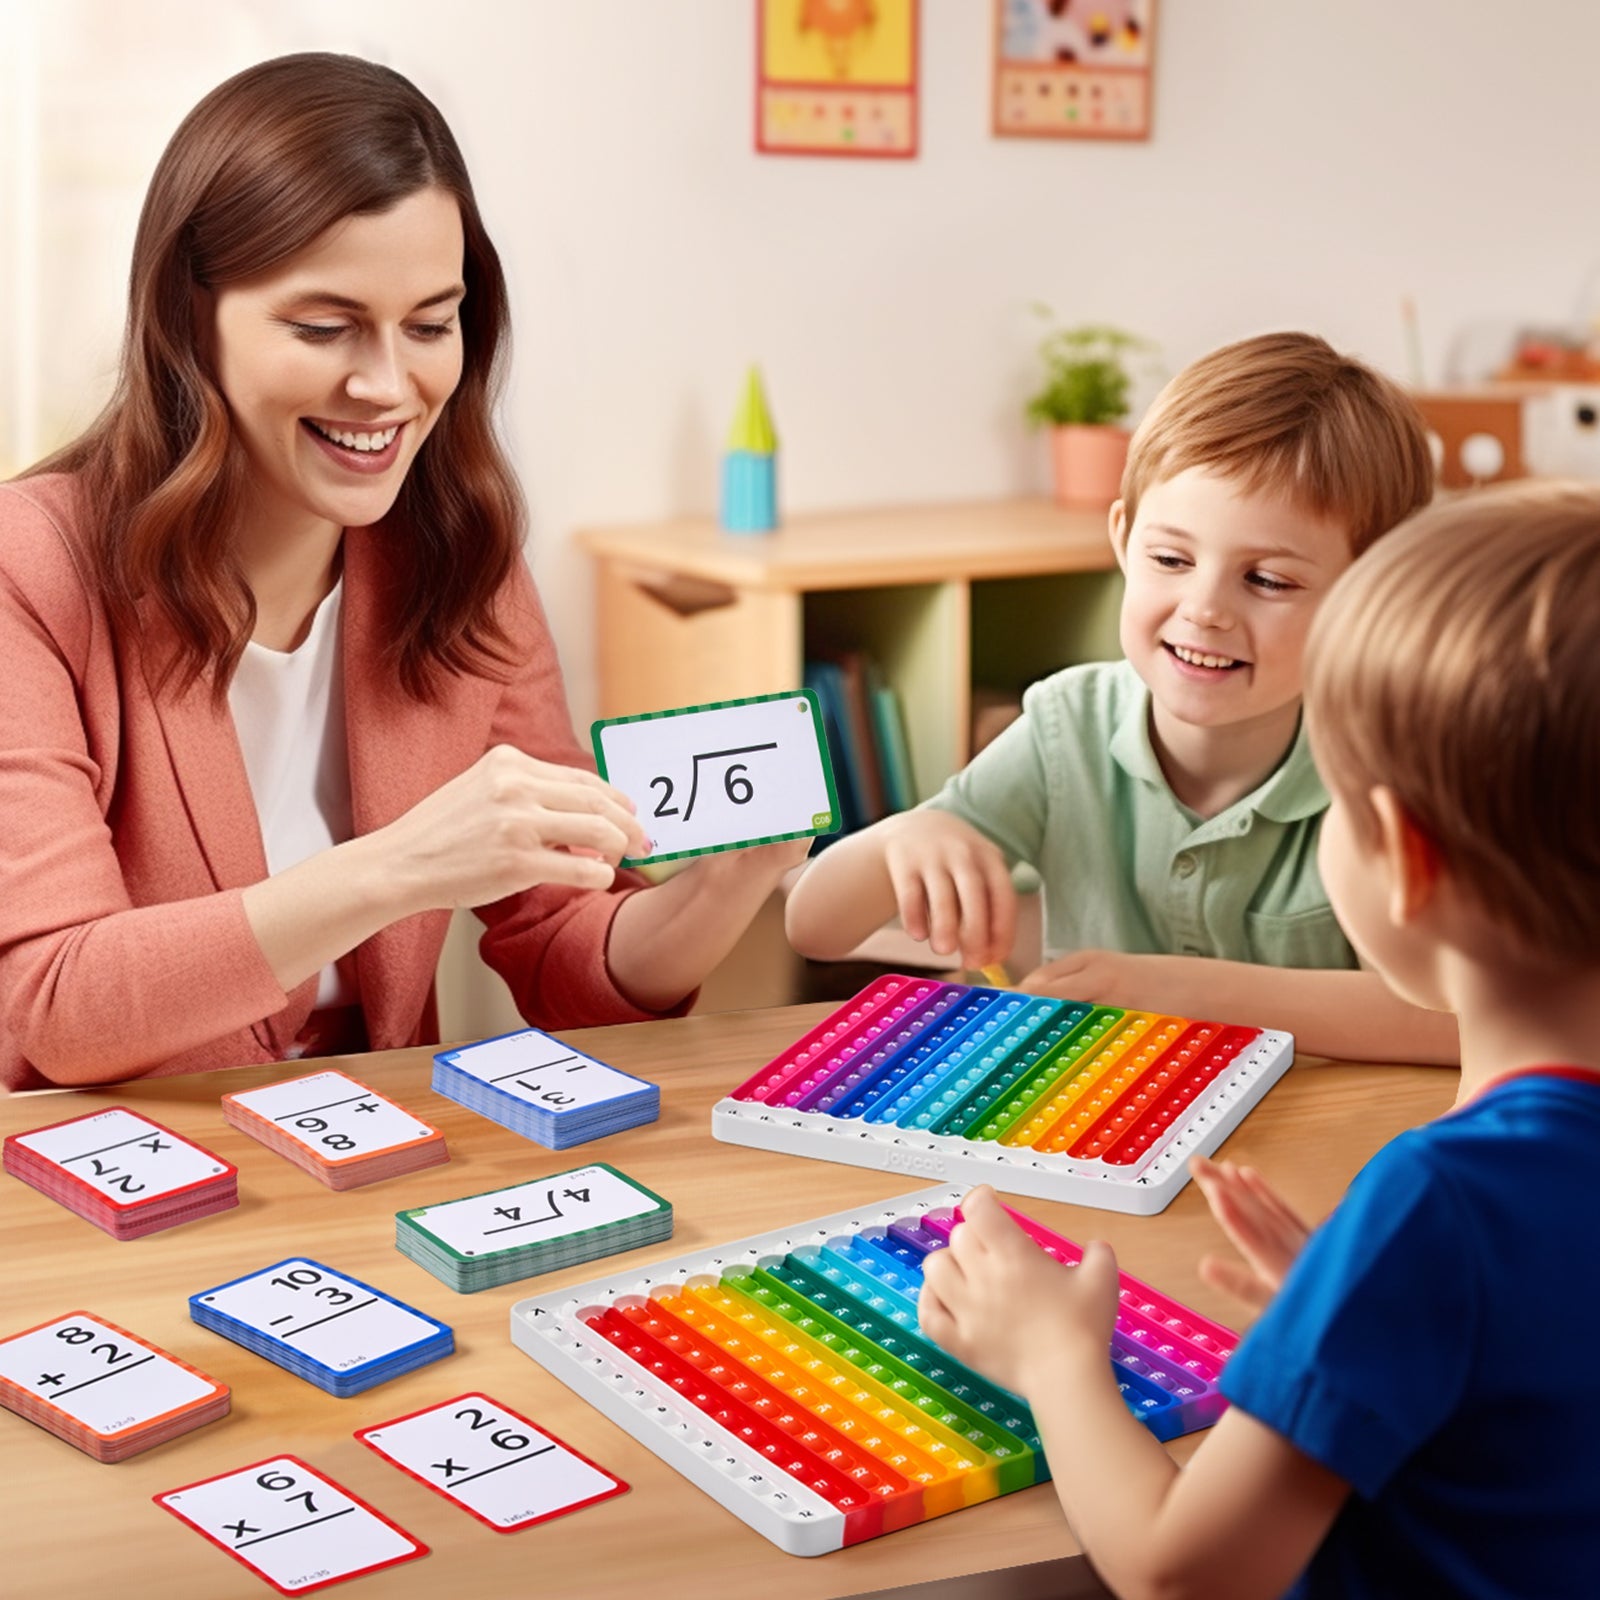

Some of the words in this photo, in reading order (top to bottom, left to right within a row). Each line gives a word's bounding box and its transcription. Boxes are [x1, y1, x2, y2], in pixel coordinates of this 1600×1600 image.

[650, 776, 679, 818] 2
[724, 764, 754, 804] 6
[541, 1091, 575, 1105] 3
[321, 1134, 356, 1151] 8
[91, 1159, 120, 1176] 7
[108, 1174, 145, 1193] 2
[563, 1188, 590, 1202] 4
[494, 1206, 520, 1221] 4
[271, 1269, 322, 1291] 10
[314, 1287, 353, 1306] 3
[56, 1326, 95, 1345] 8
[91, 1343, 133, 1365] 2
[455, 1408, 497, 1431] 2
[490, 1428, 530, 1451] 6
[256, 1471, 296, 1491] 6
[284, 1491, 319, 1513] 7
